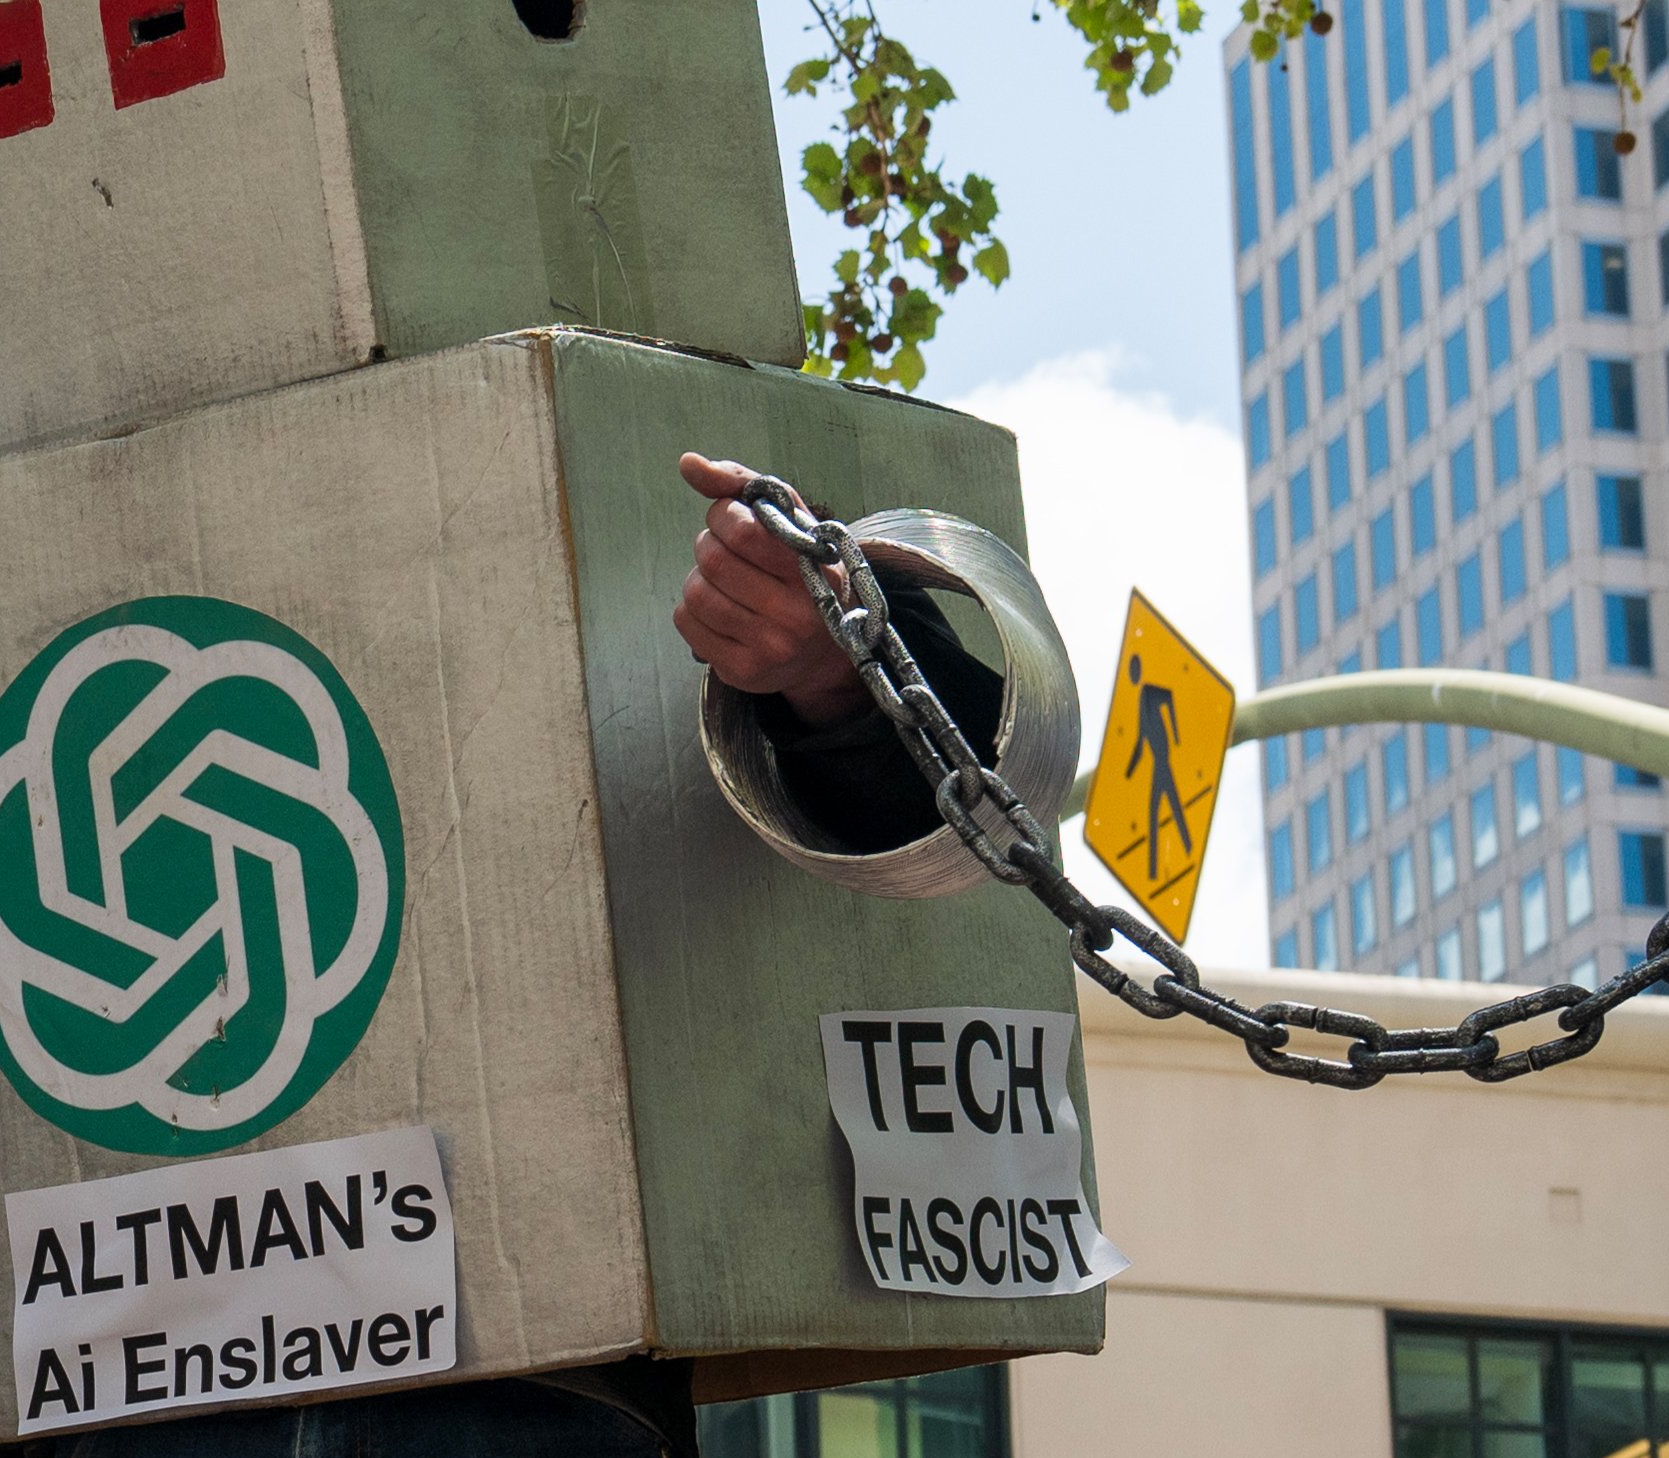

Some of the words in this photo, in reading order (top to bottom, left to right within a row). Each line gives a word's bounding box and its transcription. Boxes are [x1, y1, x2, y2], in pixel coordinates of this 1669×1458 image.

[841, 1019, 1055, 1135] TECH
[21, 1169, 438, 1305] ALTMAN's
[862, 1196, 1093, 1286] FASCIST
[25, 1343, 96, 1420] Ai
[122, 1304, 445, 1406] Enslaver
